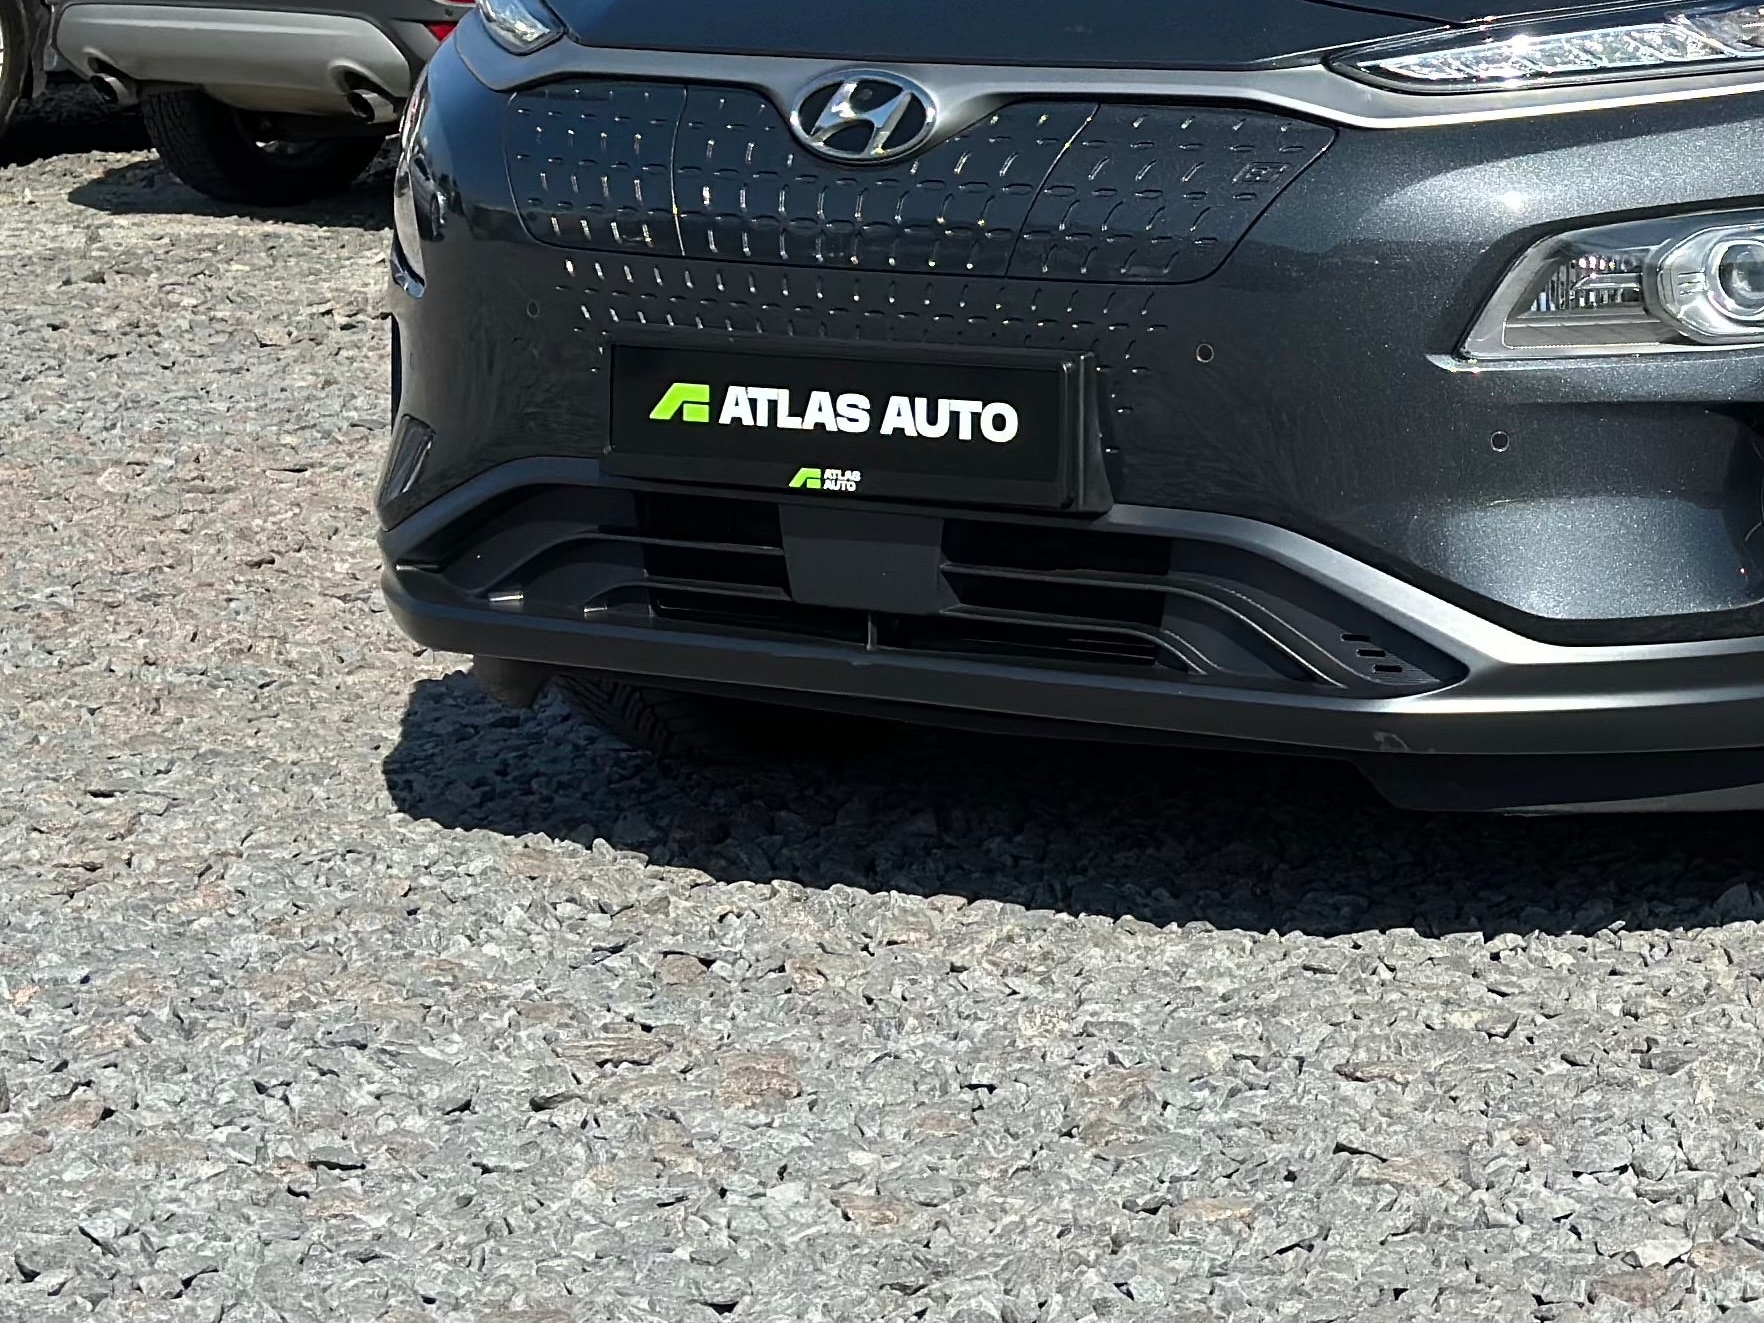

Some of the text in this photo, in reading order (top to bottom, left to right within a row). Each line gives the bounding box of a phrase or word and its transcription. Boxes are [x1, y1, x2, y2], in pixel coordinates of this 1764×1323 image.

[718, 385, 1019, 444] ATLAS AUTO
[823, 468, 862, 482] ATLAS
[823, 479, 857, 492] AUTO
